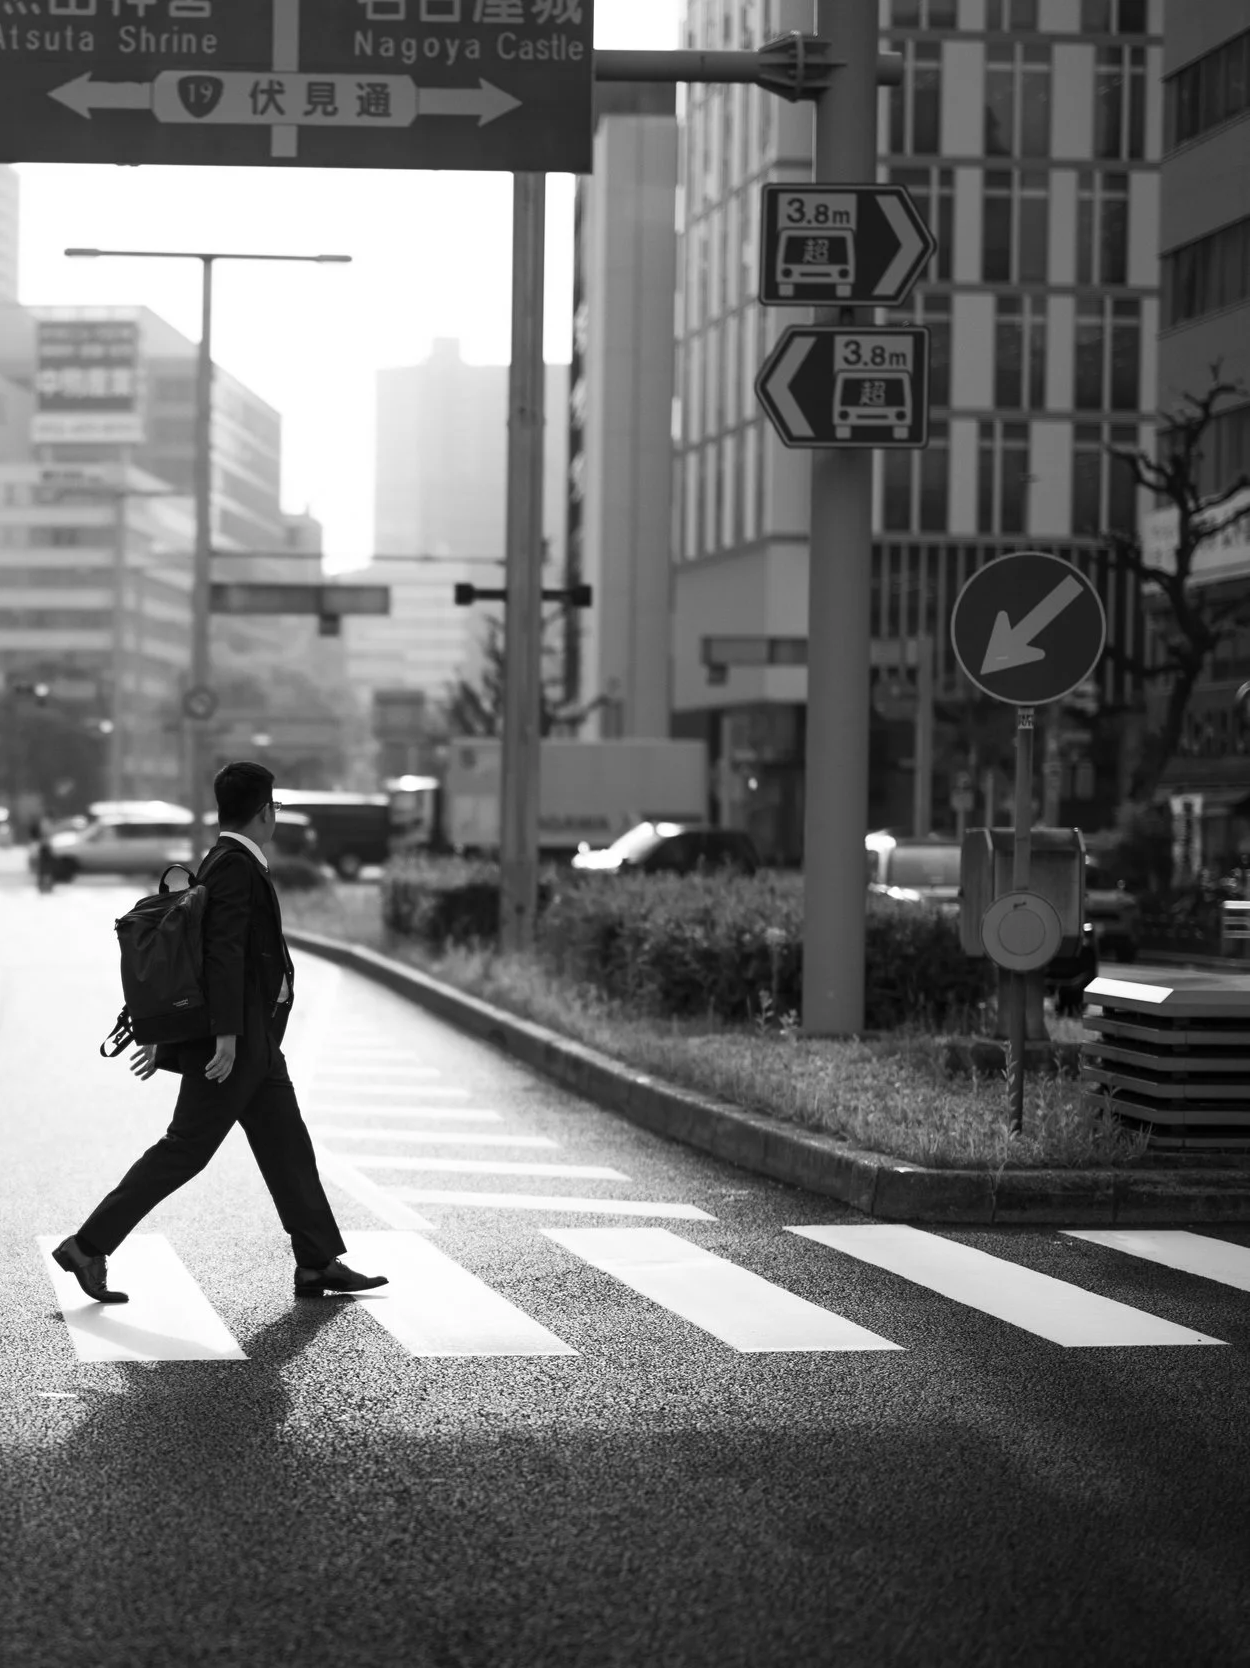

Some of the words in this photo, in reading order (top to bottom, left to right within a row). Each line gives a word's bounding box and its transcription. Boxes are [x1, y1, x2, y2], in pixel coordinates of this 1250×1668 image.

[118, 25, 218, 54] Shrine
[354, 30, 481, 65] Nagoya
[497, 32, 584, 61] Castle
[187, 82, 214, 104] 19
[248, 79, 392, 118] 伏見通
[786, 197, 851, 225] 3.8m
[842, 339, 907, 368] 3.8m
